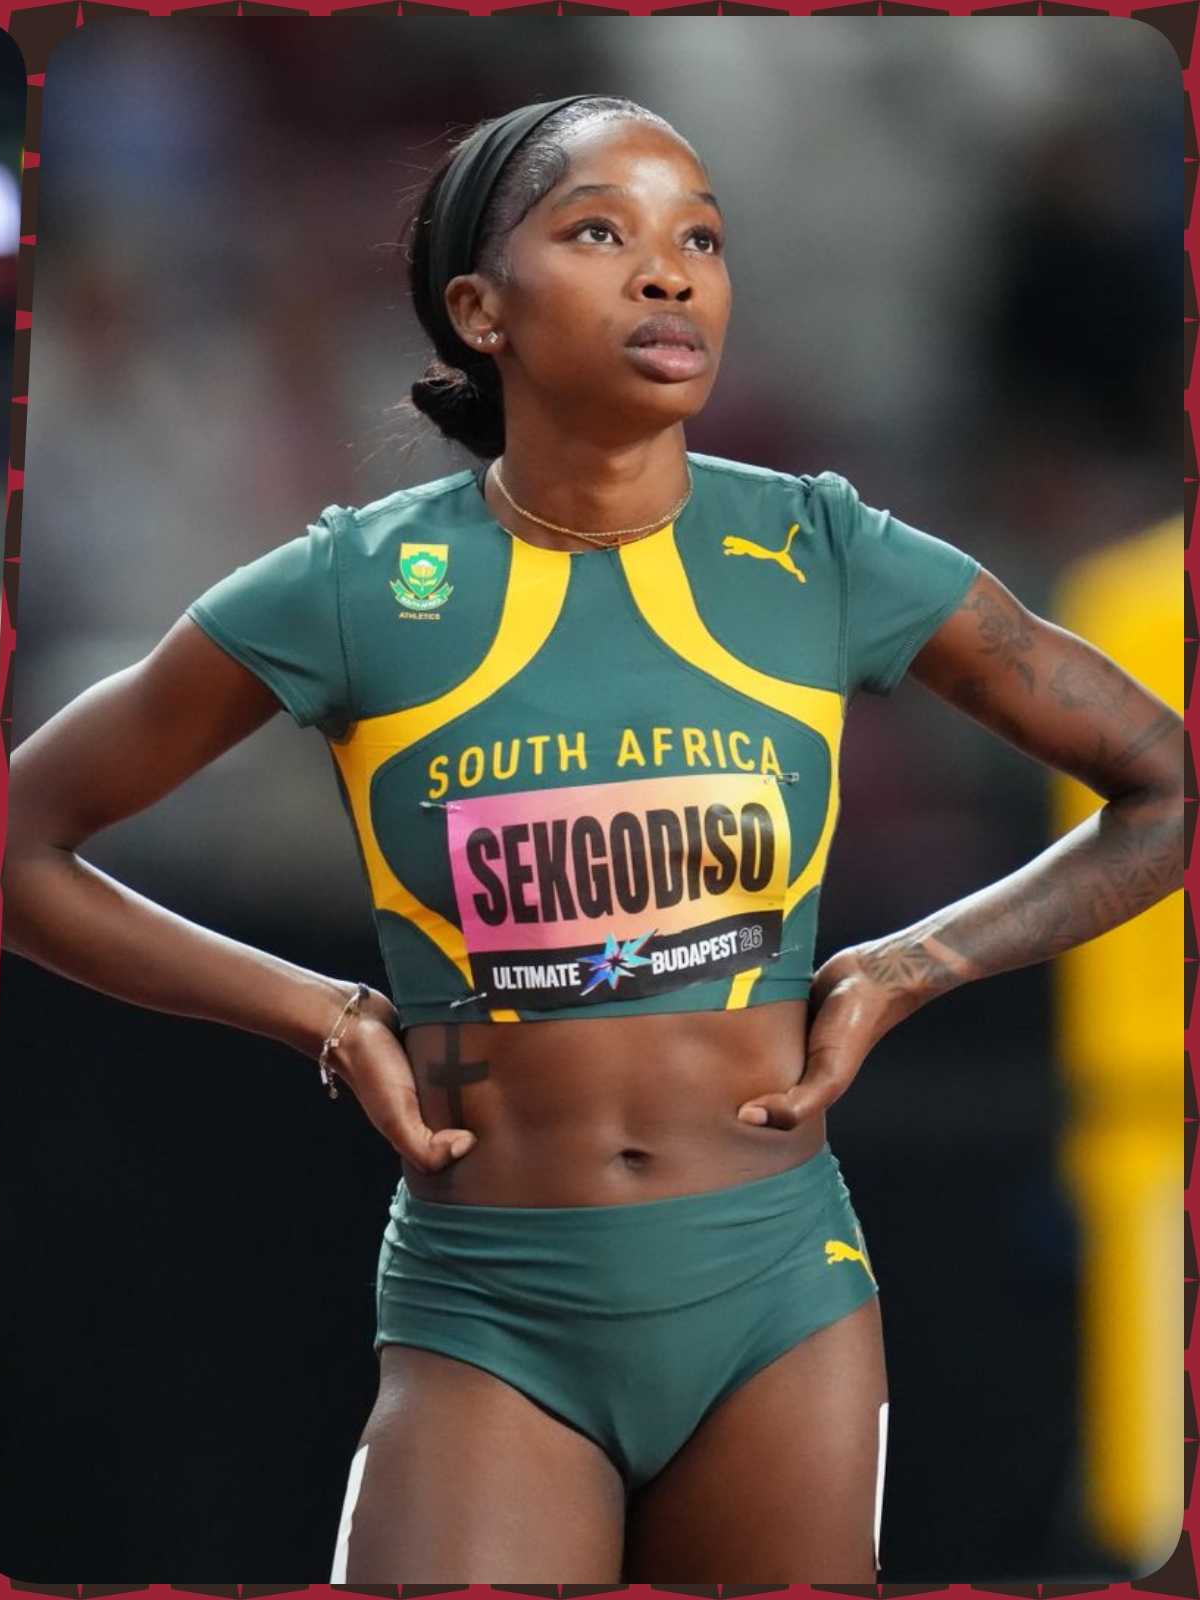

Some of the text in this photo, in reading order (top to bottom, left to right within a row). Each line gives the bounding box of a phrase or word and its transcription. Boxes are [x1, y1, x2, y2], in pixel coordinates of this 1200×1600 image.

[428, 728, 782, 799] SOUTH AFRICA
[465, 802, 776, 928] SEKGODISO
[493, 925, 763, 991] ULTIMATE BUDAPEST 26
